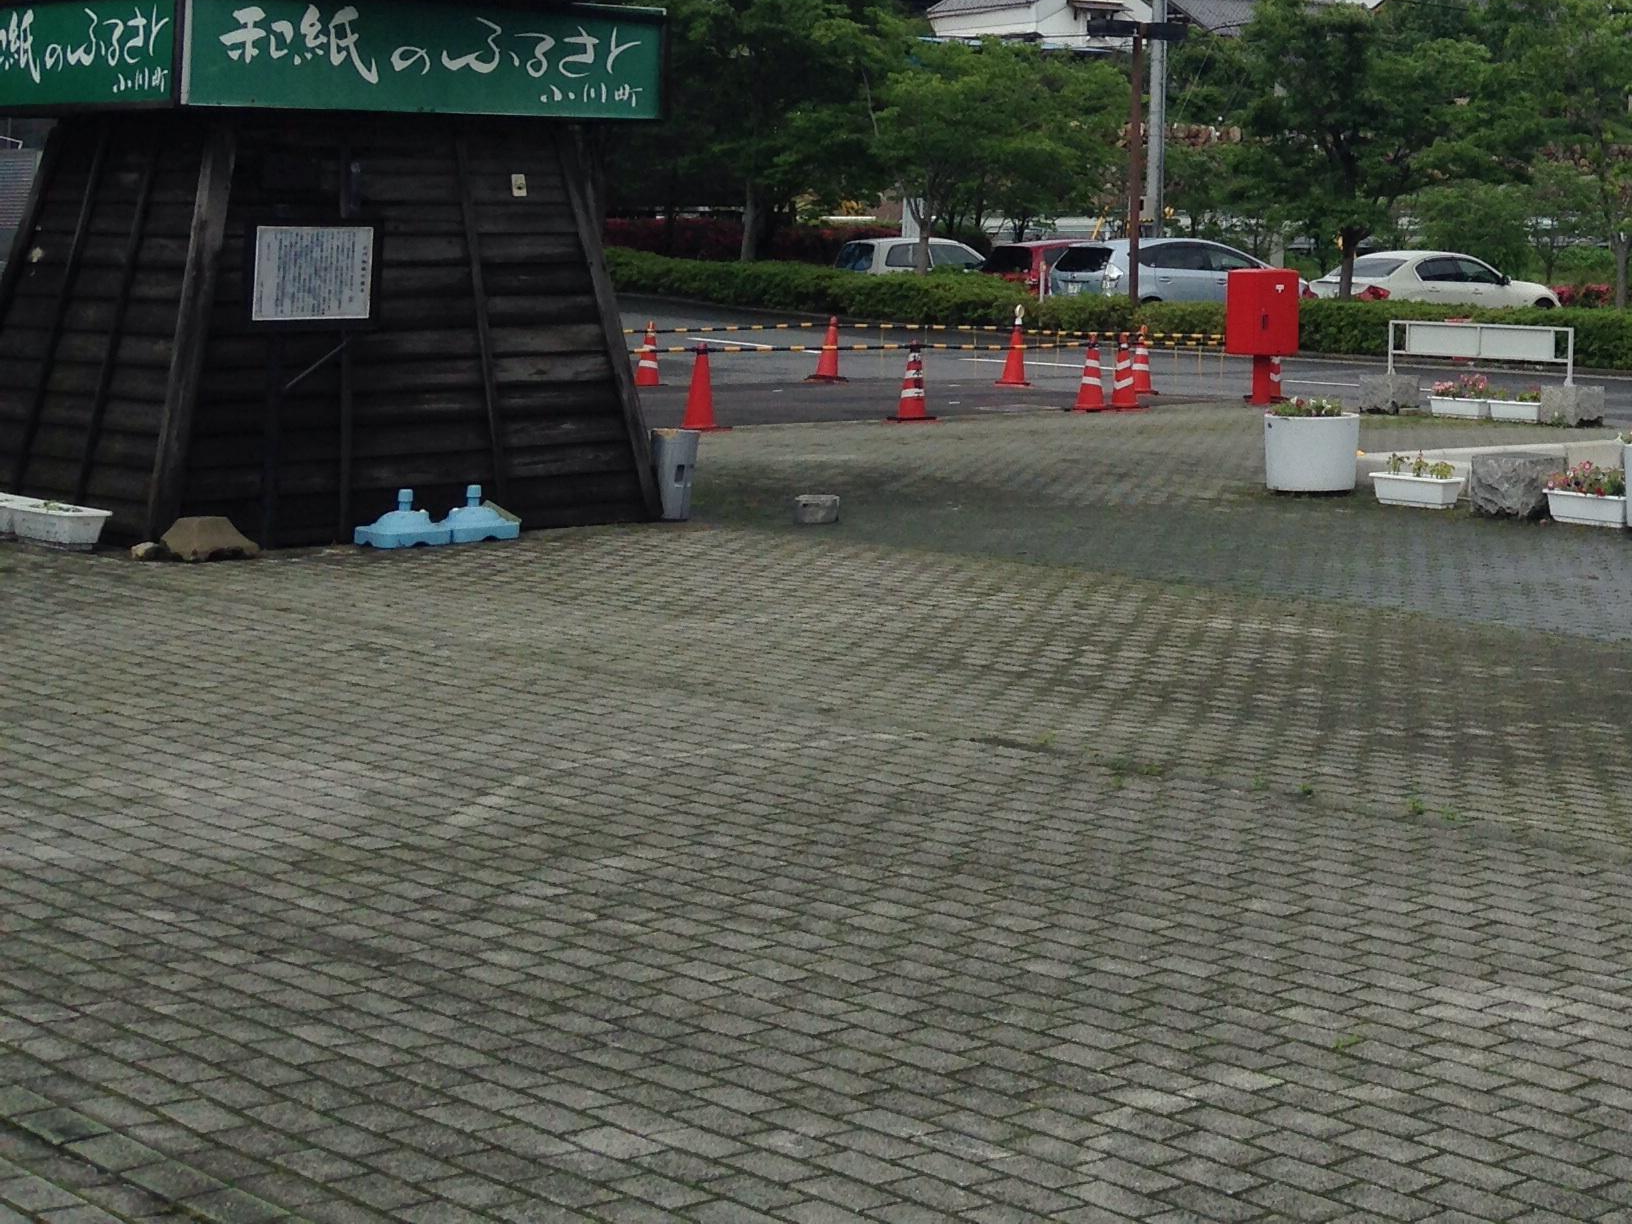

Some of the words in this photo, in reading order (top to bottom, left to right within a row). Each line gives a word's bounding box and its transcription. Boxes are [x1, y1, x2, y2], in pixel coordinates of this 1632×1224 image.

[0, 3, 169, 84] 紙のふるさと
[219, 3, 642, 84] 和紙のふるさと
[113, 66, 169, 93] 小川町
[539, 82, 642, 108] 小川町
